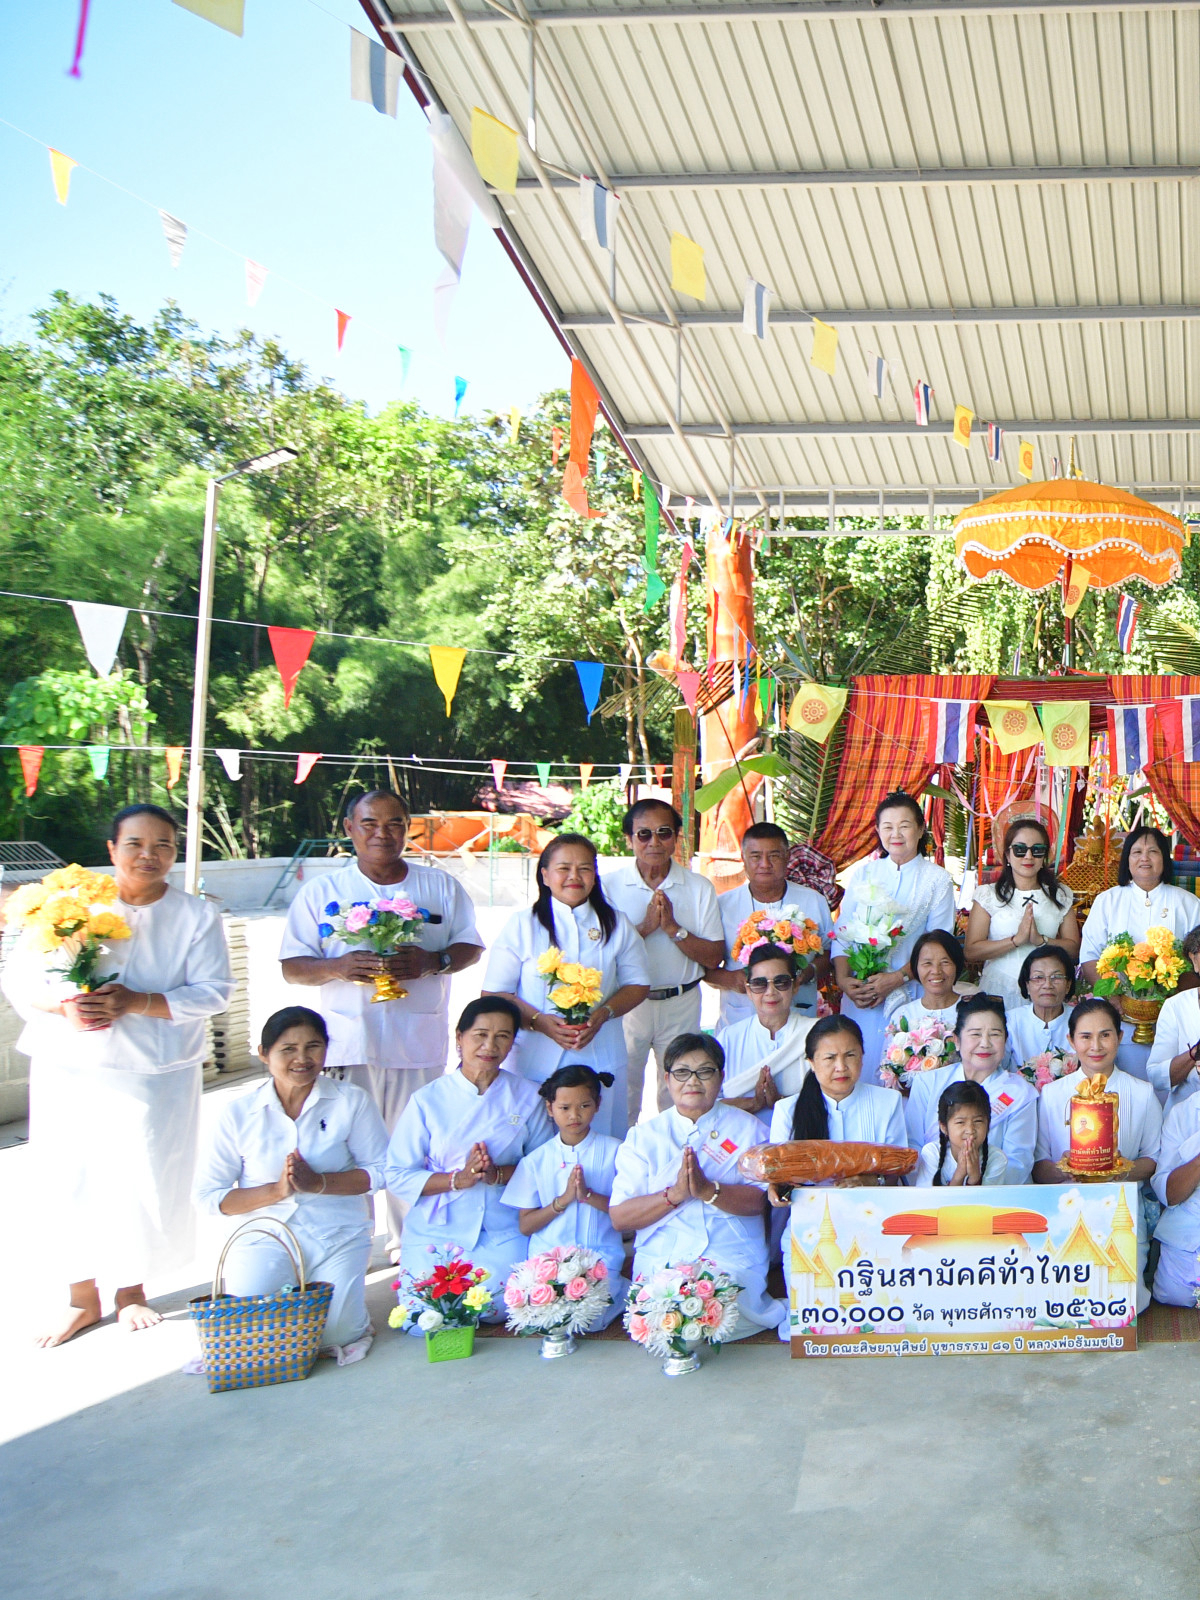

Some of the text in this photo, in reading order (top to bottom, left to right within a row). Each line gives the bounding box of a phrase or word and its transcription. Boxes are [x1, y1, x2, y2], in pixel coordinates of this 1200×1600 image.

[837, 1248, 1091, 1297] กฐินสามัคคีทั่วไทย
[802, 1297, 1127, 1327] ๓๐,๐๐๐ วัด พุทธศักราช ๒๕๖๘
[804, 1334, 1123, 1356] โดย คณะศิษยานุศิษย์ บูชาธรรม ๘๑ ปี หลวงพ่อธัมมชโย
